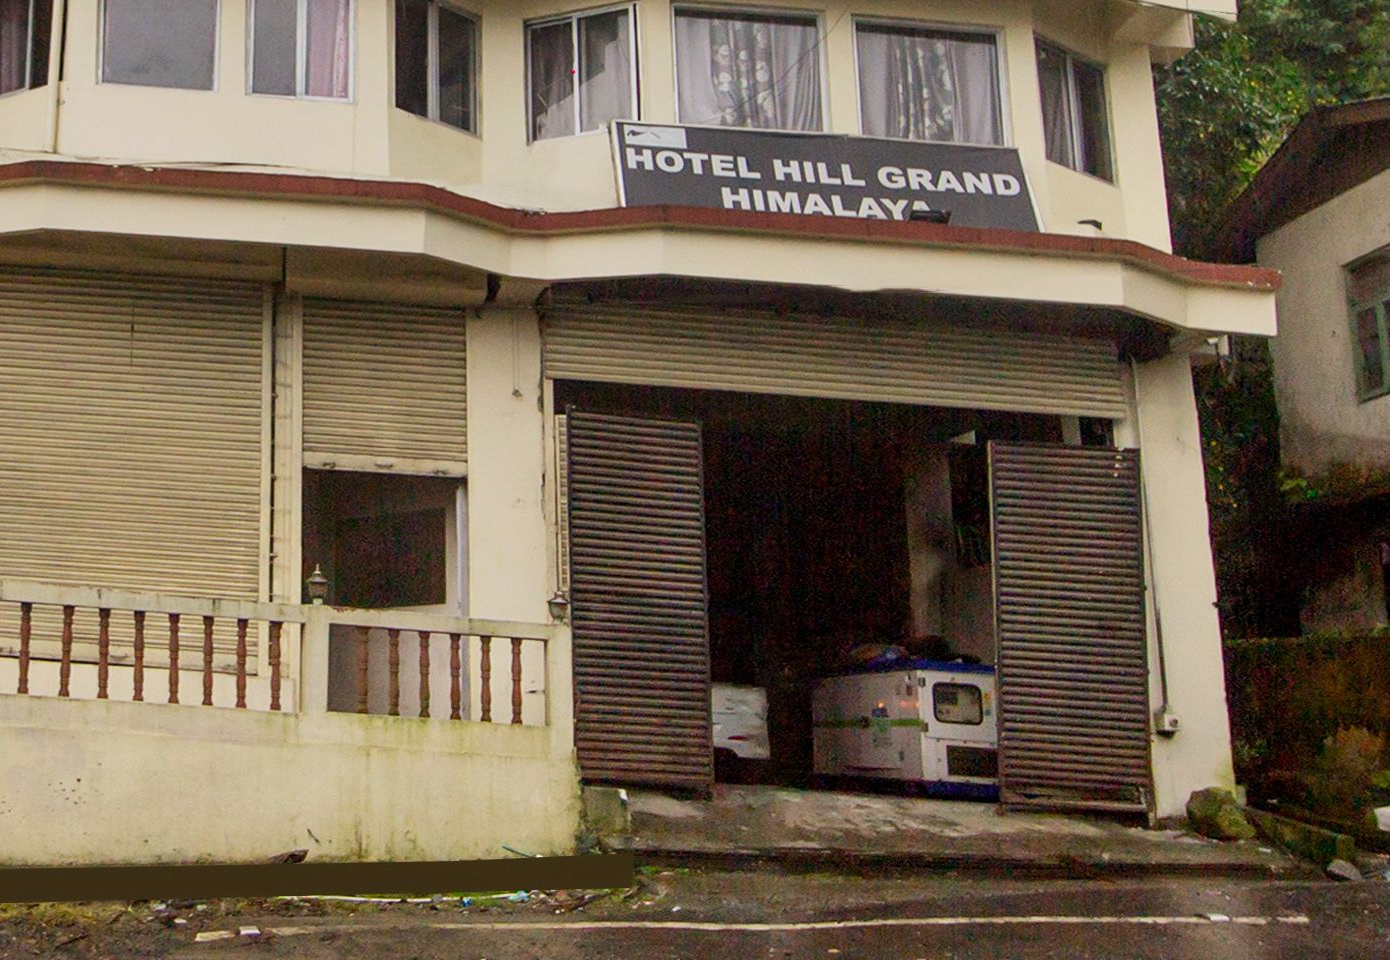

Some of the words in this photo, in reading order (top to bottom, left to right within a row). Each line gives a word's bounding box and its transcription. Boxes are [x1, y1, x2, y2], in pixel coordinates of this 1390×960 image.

[625, 147, 762, 180] HOTEL
[773, 158, 866, 187] HILL
[877, 166, 1021, 196] GRAND
